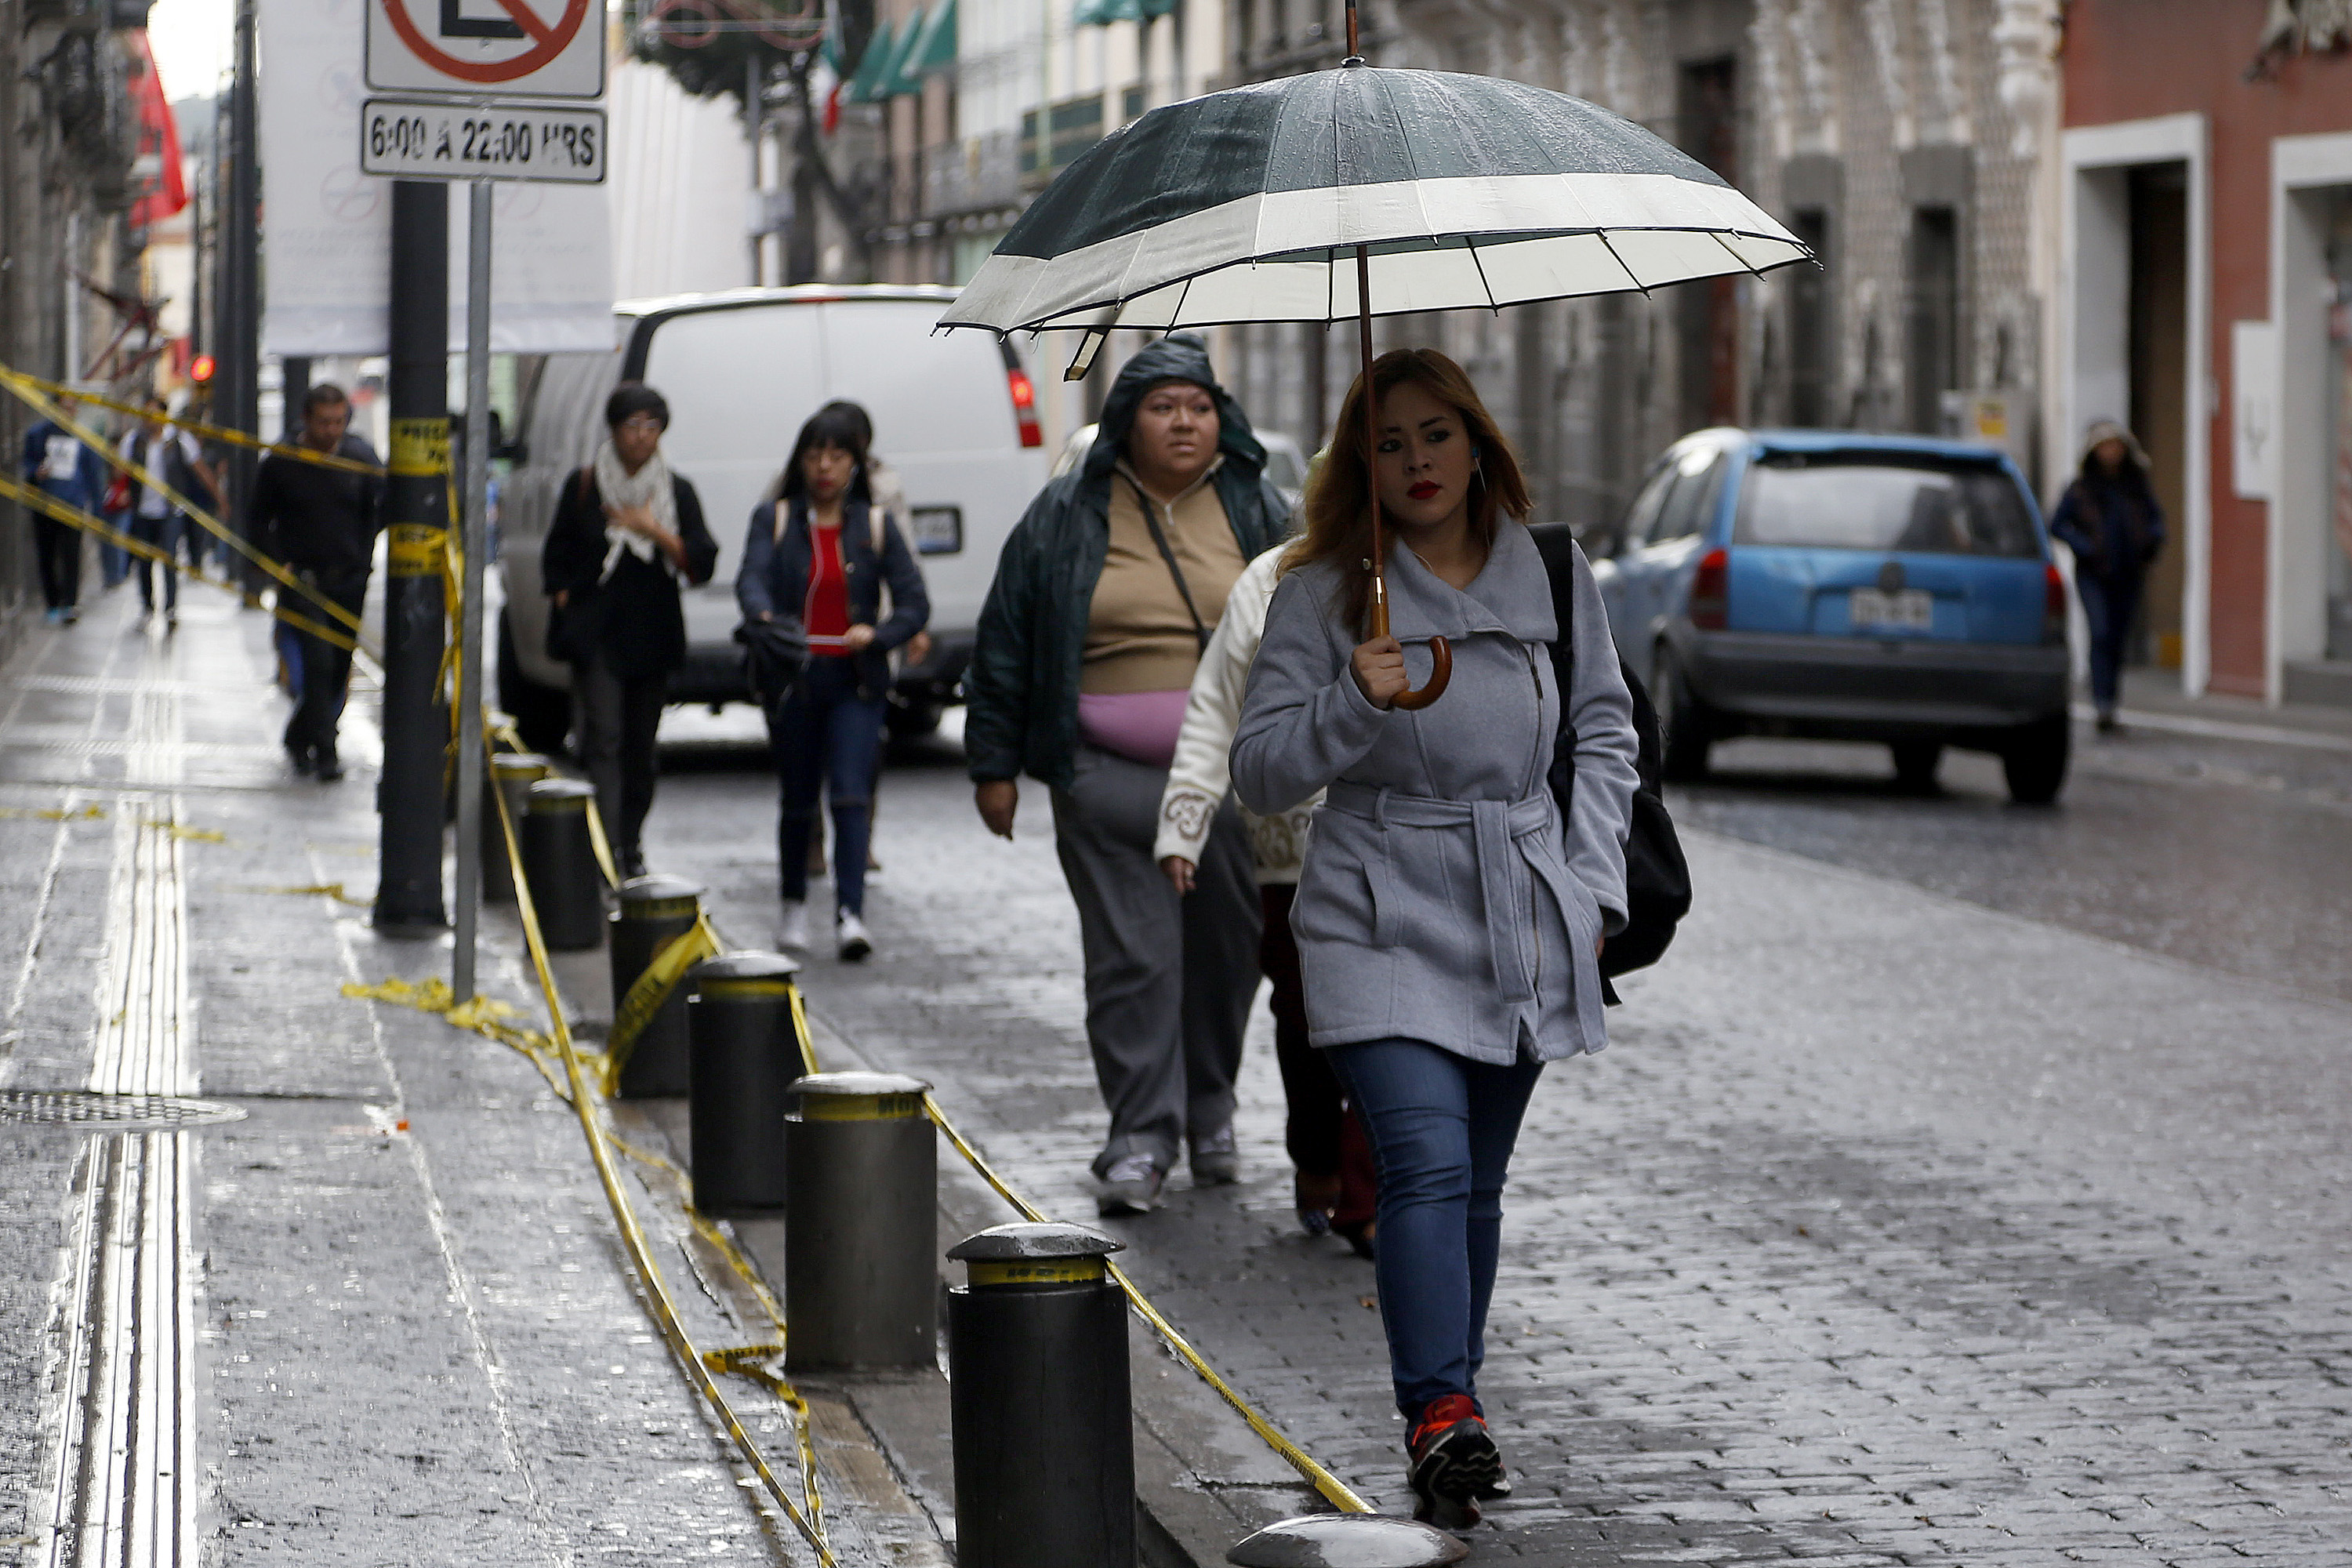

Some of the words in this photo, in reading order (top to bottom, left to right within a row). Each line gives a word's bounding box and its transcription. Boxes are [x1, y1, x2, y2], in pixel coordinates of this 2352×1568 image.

[372, 115, 426, 159] 6:00
[434, 120, 453, 161] A
[461, 118, 532, 163] 22:00
